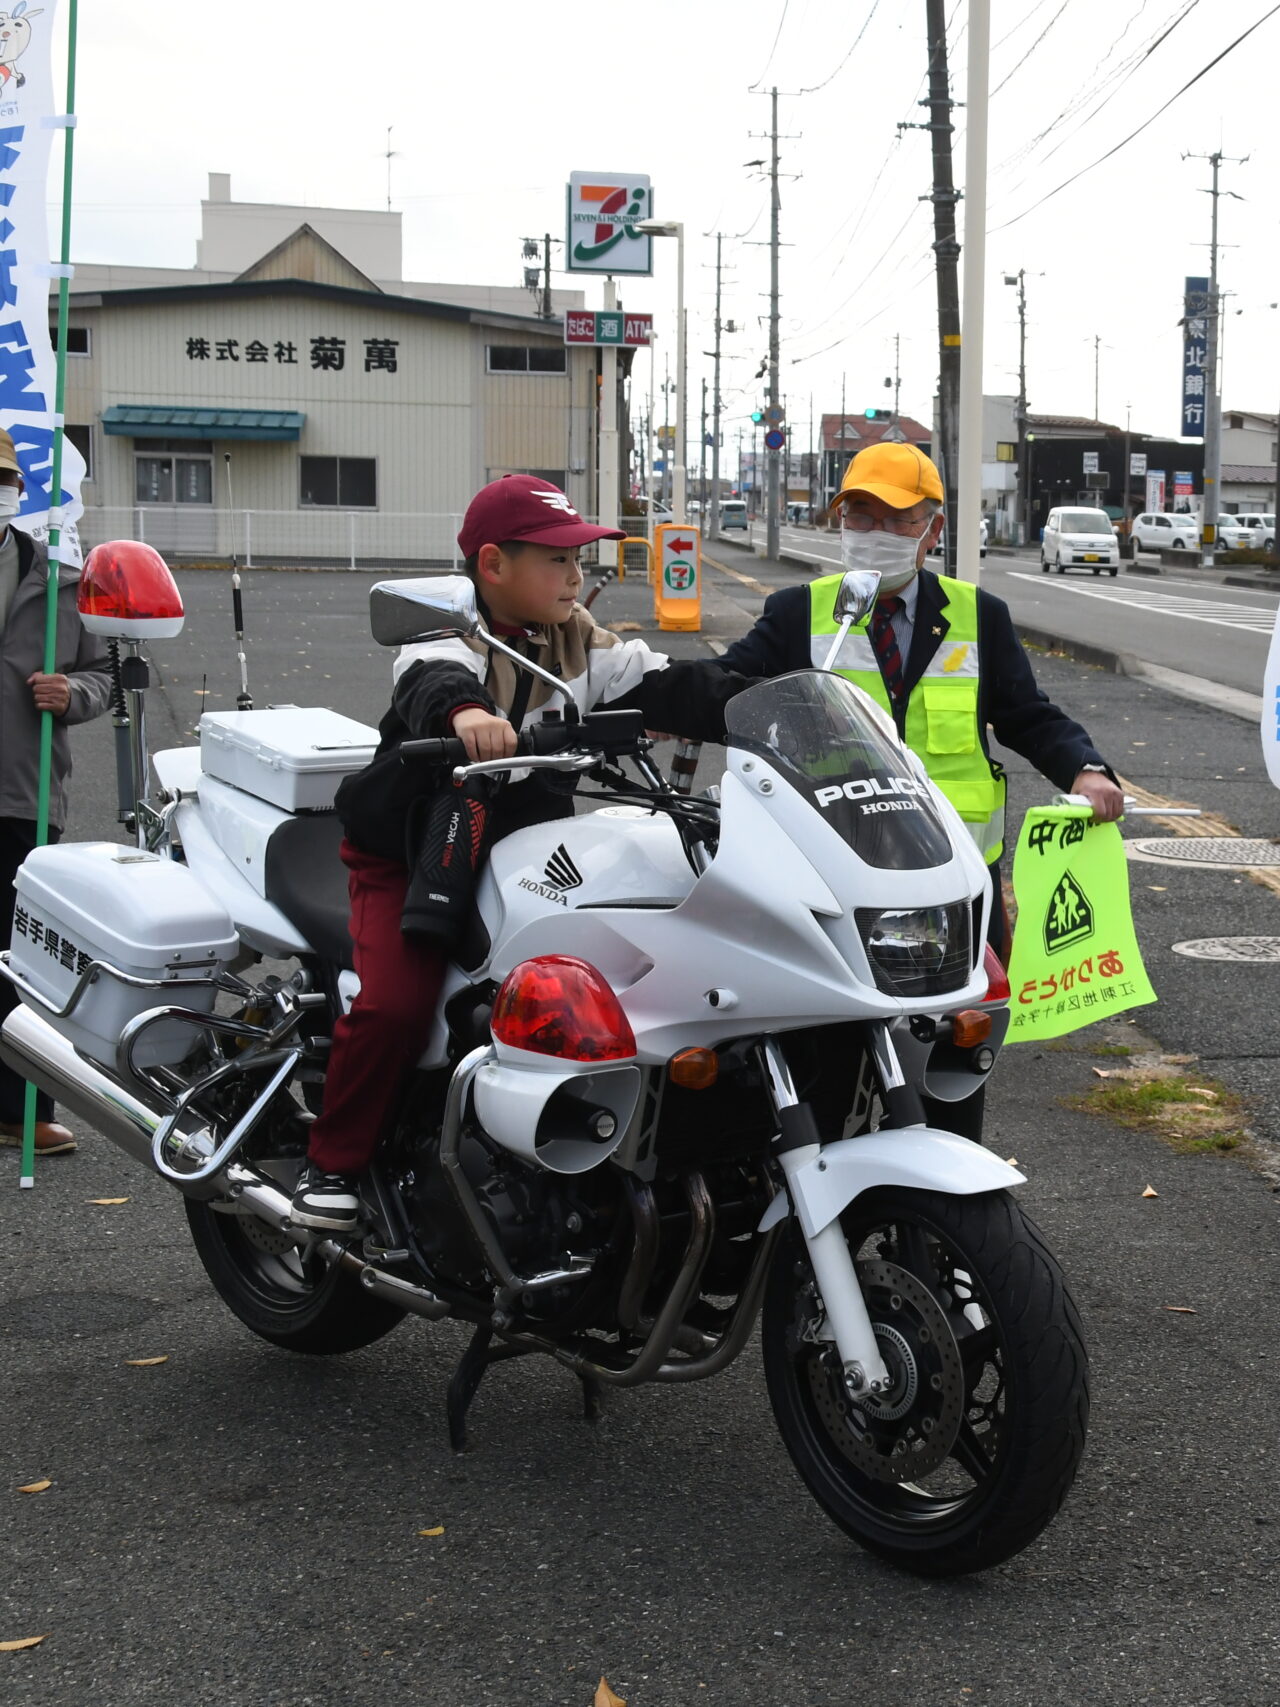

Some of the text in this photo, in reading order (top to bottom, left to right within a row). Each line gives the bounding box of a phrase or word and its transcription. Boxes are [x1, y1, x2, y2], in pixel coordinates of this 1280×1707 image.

[567, 317, 650, 338] たばこ 酒 ATM
[186, 337, 298, 364] 株式会社
[813, 777, 930, 808] POLICE
[859, 800, 923, 816] HONDA
[517, 877, 569, 907] HONDA
[14, 904, 95, 977] 岩手県警察
